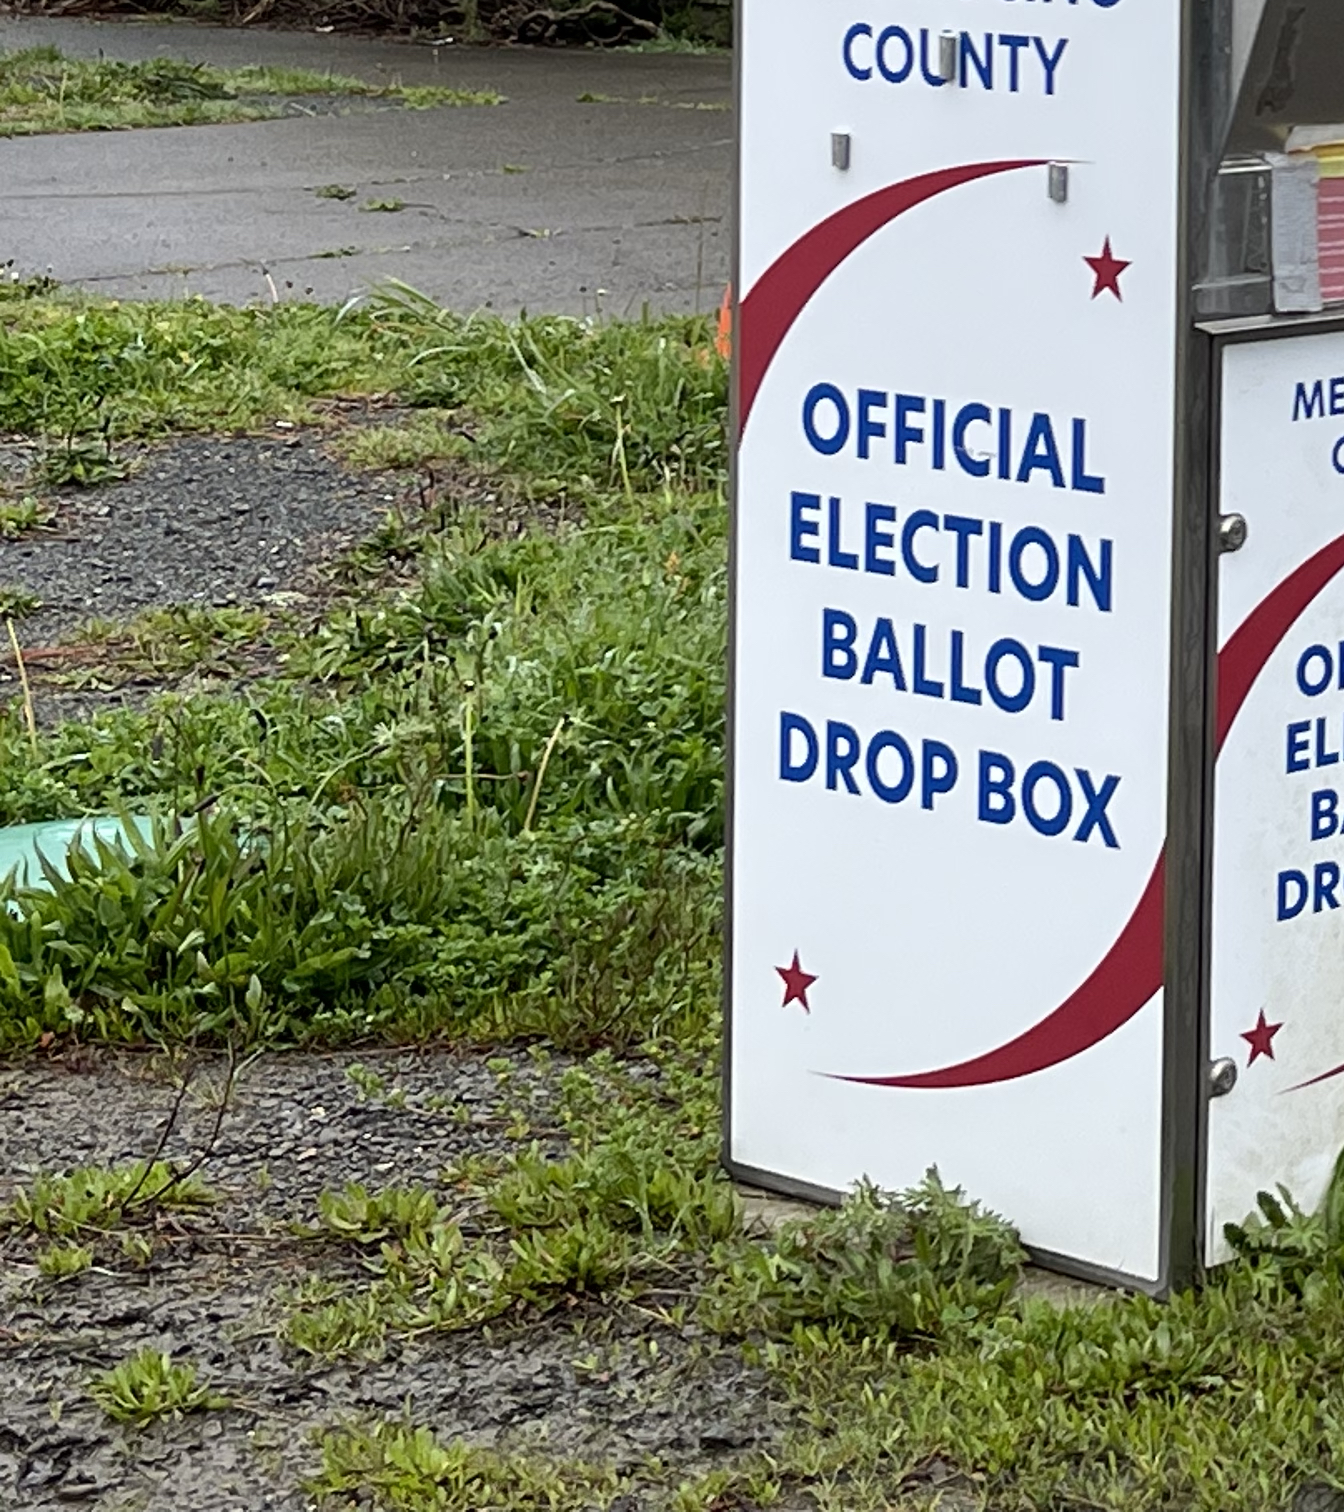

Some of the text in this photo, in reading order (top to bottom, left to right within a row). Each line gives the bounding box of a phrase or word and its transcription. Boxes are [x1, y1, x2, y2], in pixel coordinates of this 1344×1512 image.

[842, 22, 1068, 95] COUNTY
[802, 381, 1105, 494] OFFICIAL
[789, 490, 1114, 612] ELECTION
[821, 607, 1080, 721] BALLOT
[779, 710, 1122, 850] DROP BOX
